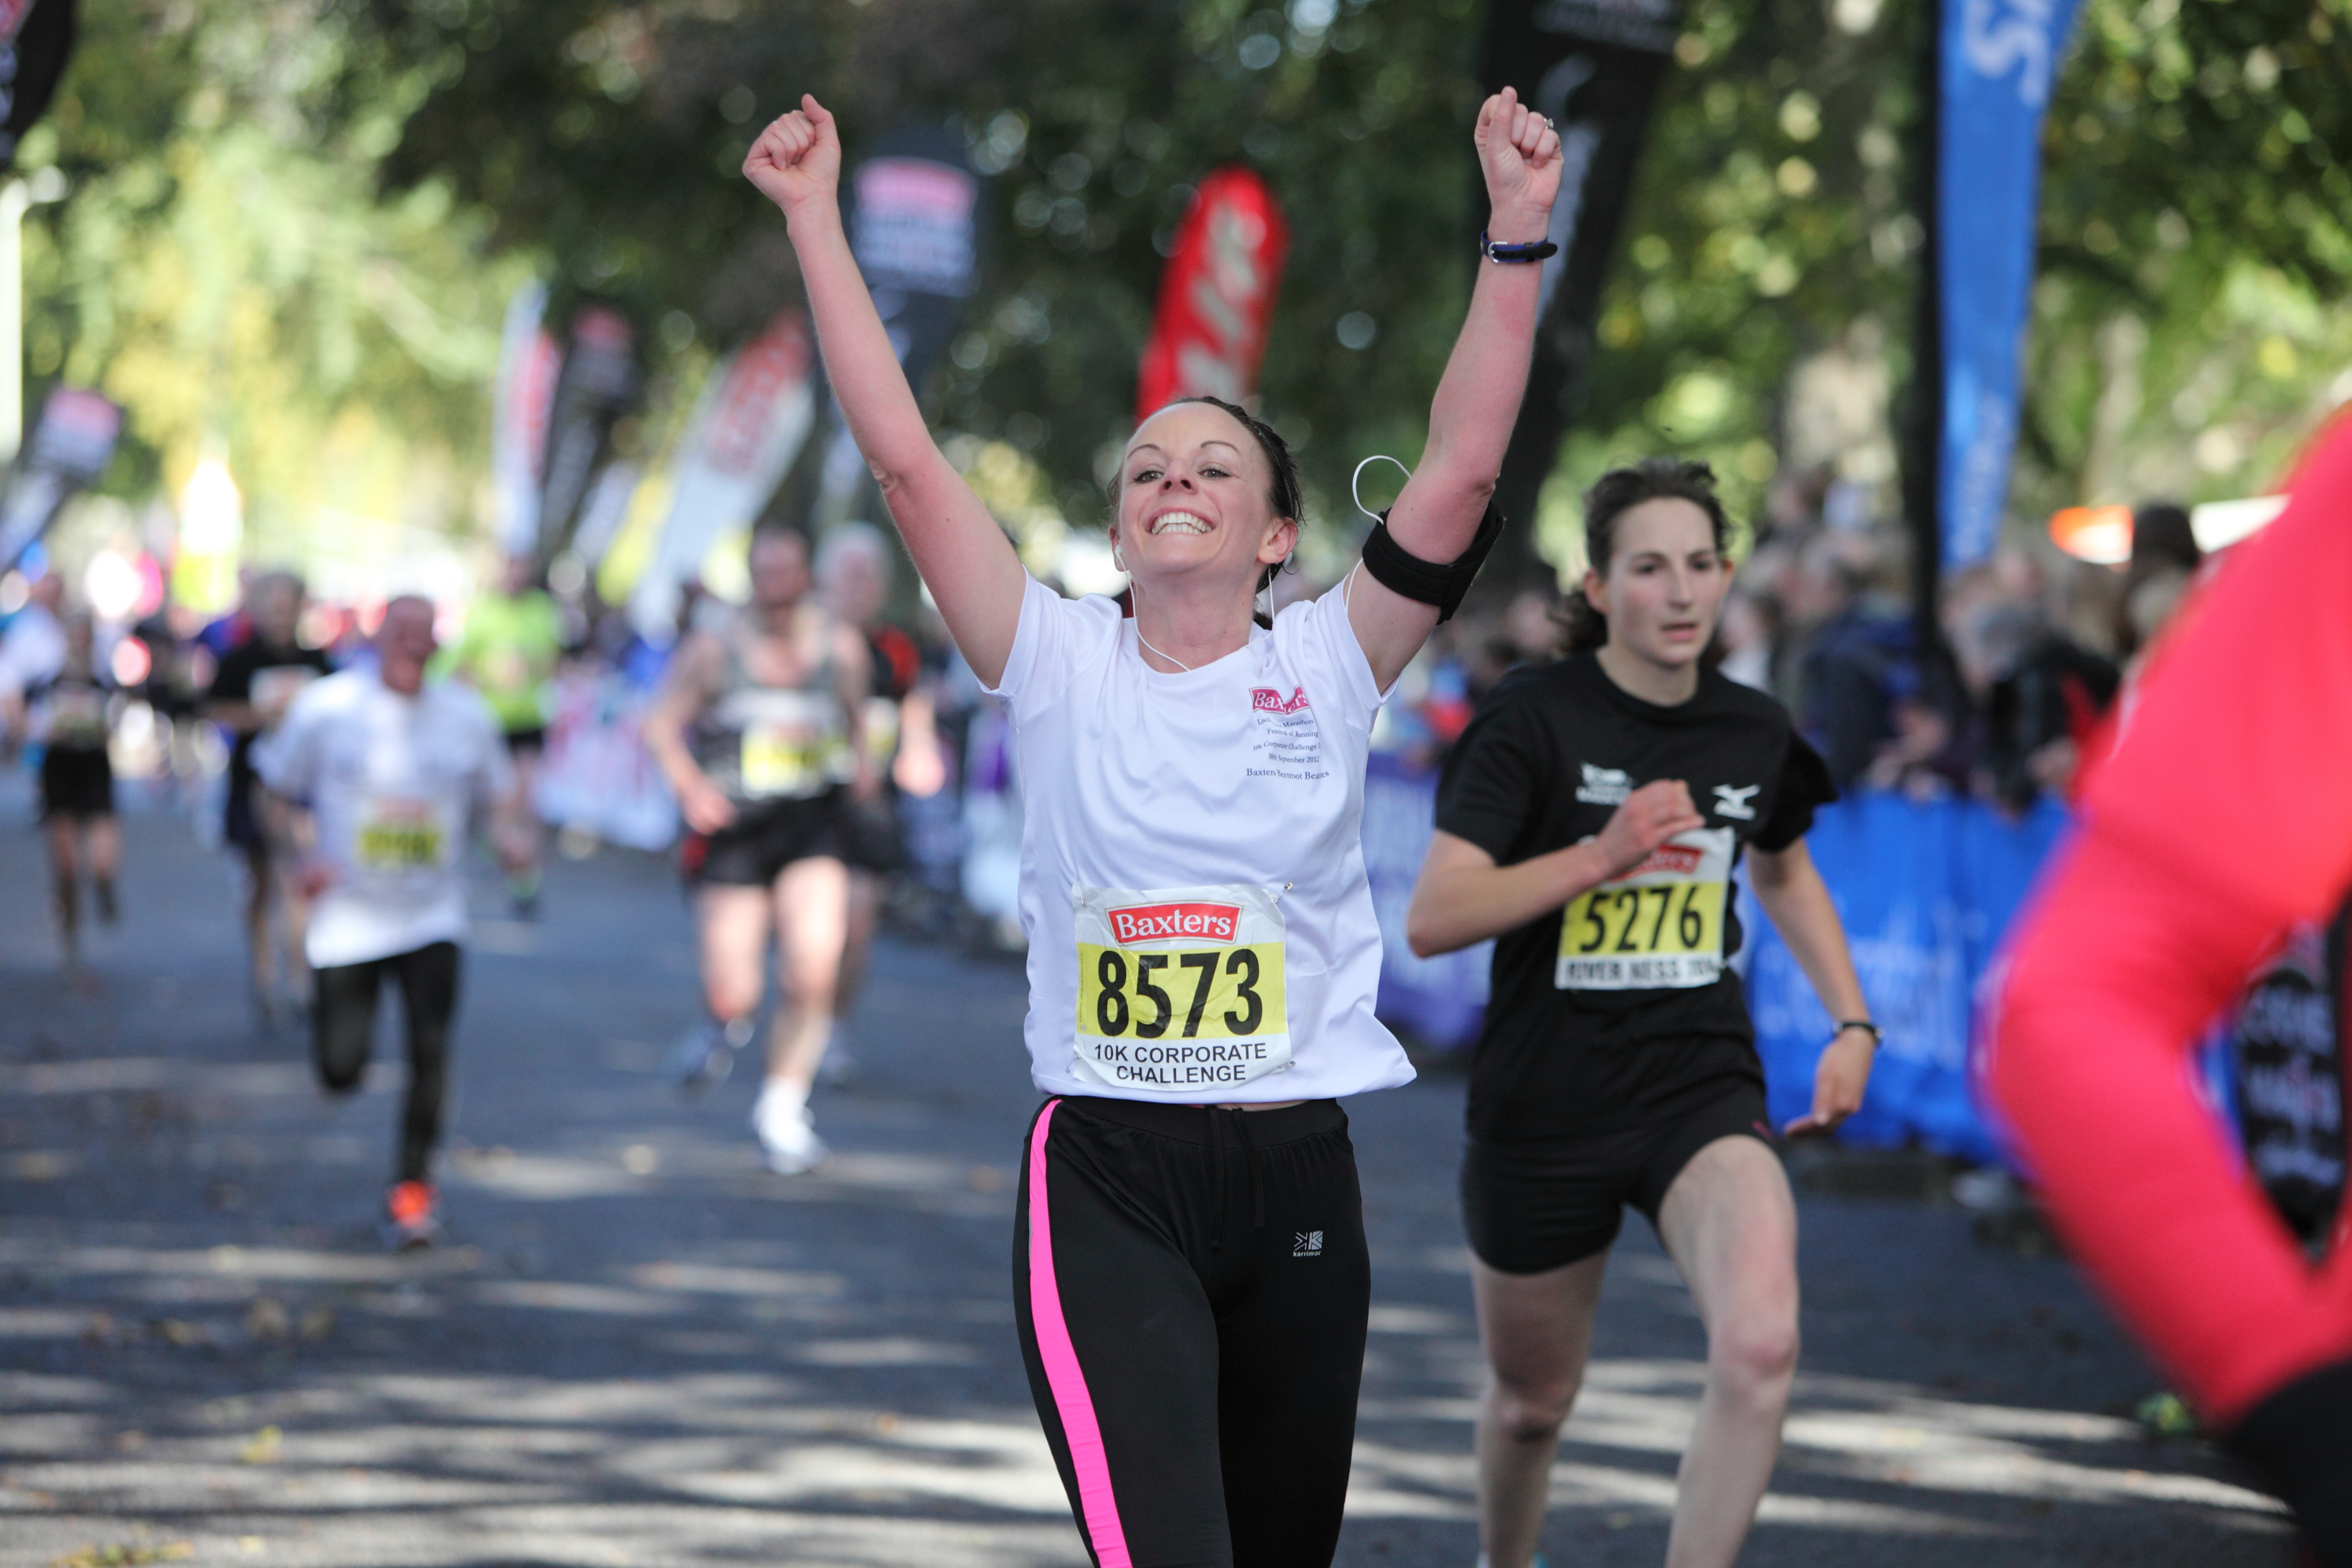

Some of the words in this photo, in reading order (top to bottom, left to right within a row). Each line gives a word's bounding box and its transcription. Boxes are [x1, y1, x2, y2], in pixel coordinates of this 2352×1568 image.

[1267, 728, 1288, 736] Festival
[1295, 730, 1319, 738] Running
[1282, 718, 1314, 728] Marathon
[1264, 741, 1288, 750] Corporate
[1288, 743, 1317, 752] Challenge
[1268, 753, 1277, 761] 30th
[1278, 754, 1305, 764] September
[1246, 768, 1277, 776] Baxters
[1277, 769, 1303, 780] Beetroot
[1115, 909, 1232, 939] Baxters
[1579, 885, 1702, 952] 5276
[1567, 961, 1622, 981] RIVER
[1629, 960, 1679, 981] NESS
[1097, 948, 1263, 1039] 8573
[1094, 1043, 1128, 1061] 10K
[1134, 1042, 1267, 1064] CORPORATE
[1116, 1064, 1247, 1084] CHALLENGE
